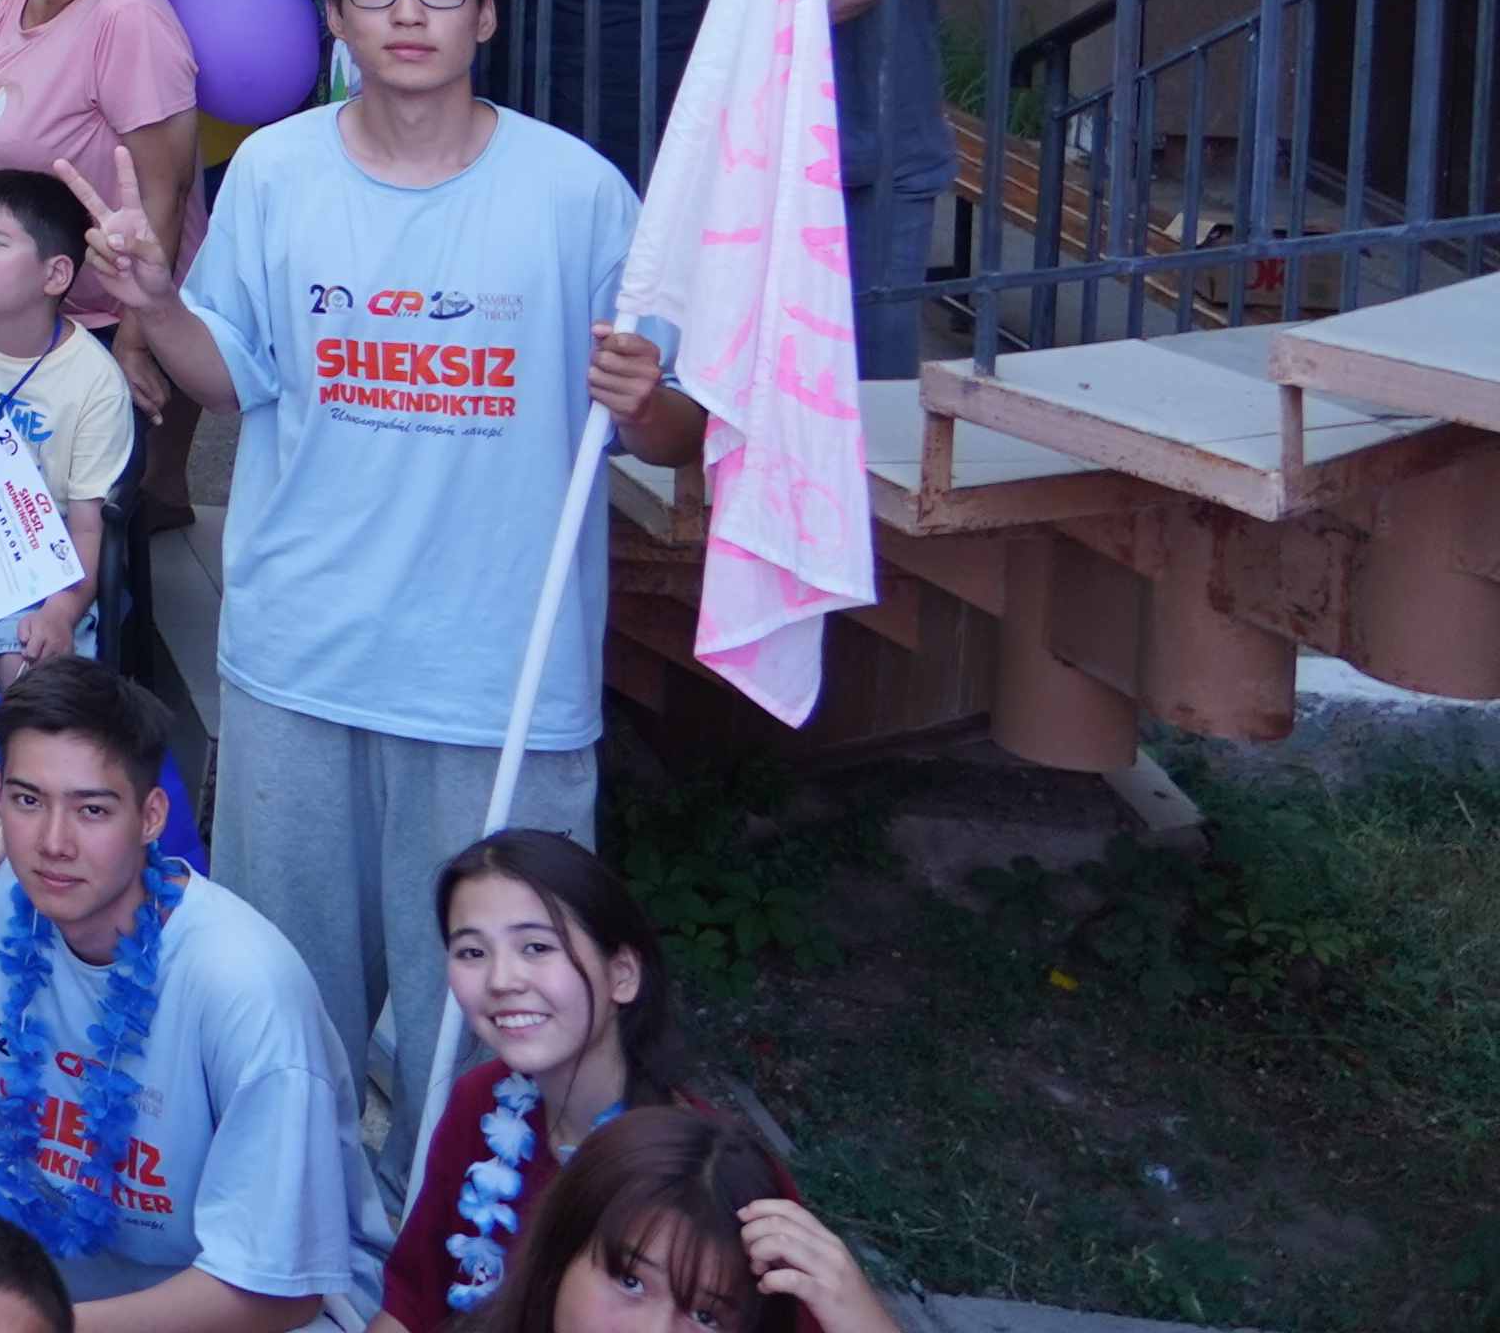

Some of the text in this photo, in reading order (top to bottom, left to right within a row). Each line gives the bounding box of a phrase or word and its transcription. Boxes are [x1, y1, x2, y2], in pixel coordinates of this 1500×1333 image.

[310, 285, 353, 313] 20
[316, 338, 515, 387] SHEKSIZ
[319, 383, 516, 416] MUMKINDIKTER
